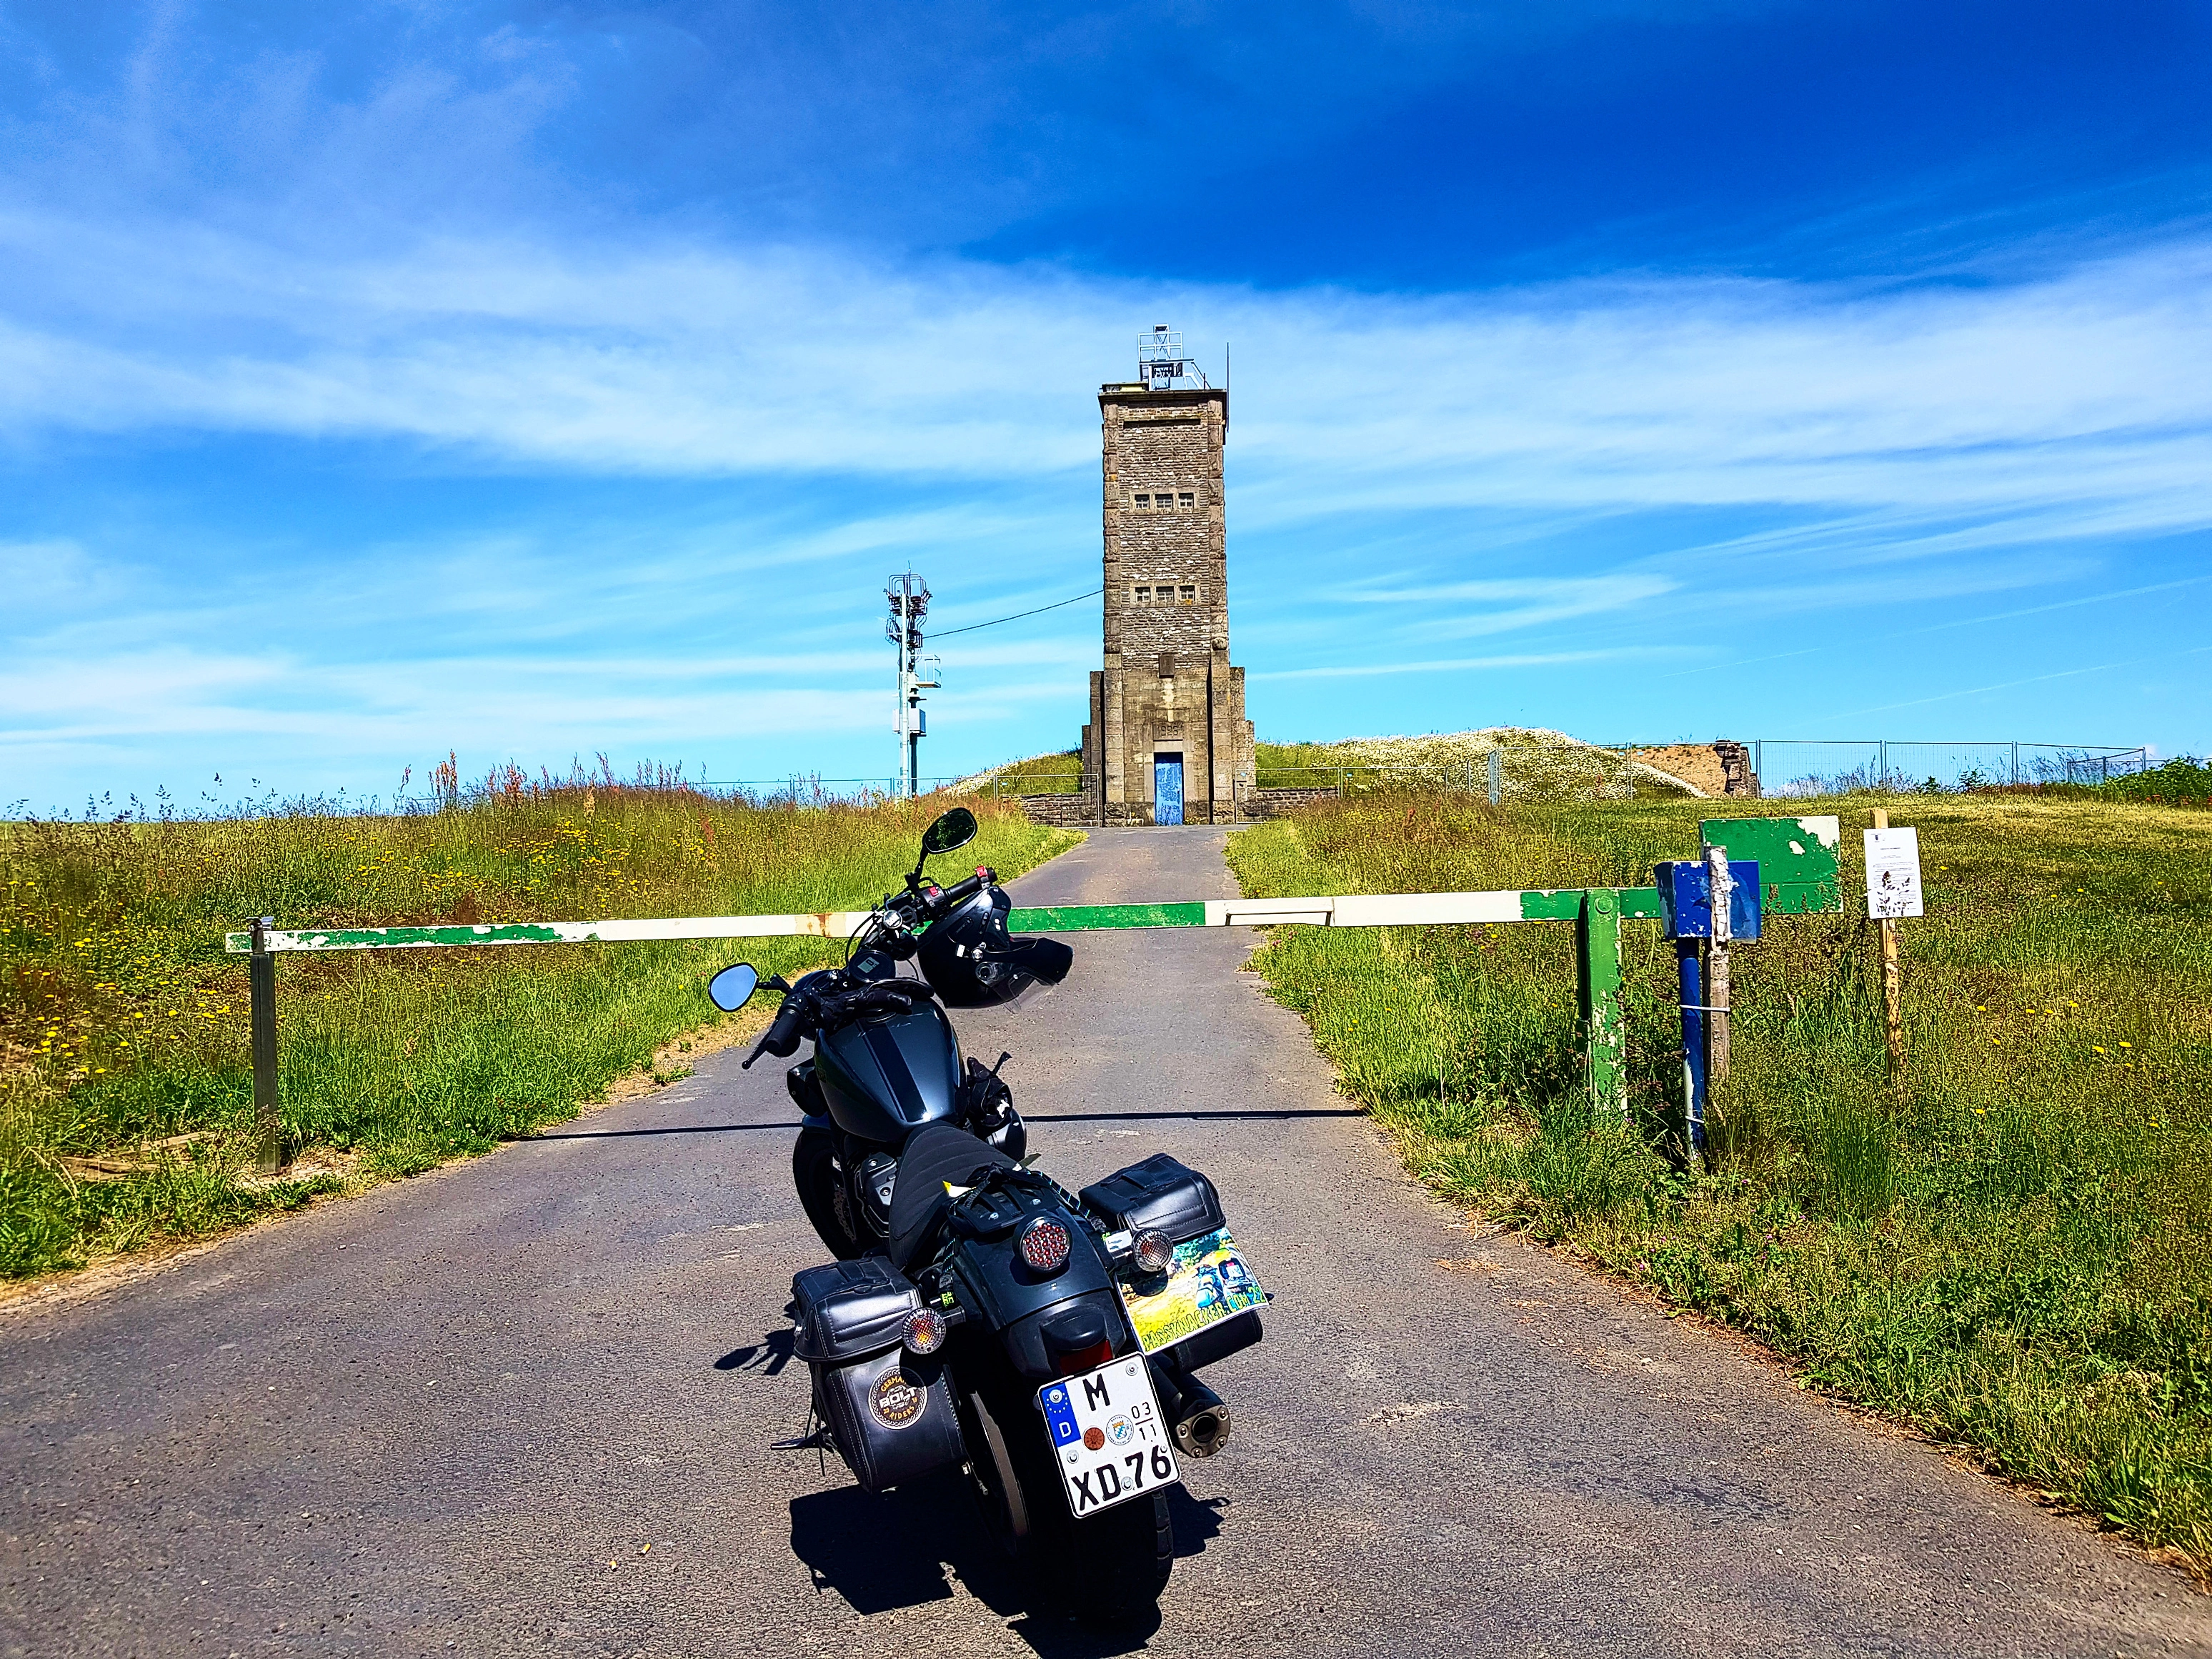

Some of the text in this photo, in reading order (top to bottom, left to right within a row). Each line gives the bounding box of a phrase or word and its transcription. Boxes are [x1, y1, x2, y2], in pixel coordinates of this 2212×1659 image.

[1141, 1285, 1266, 1352] PASSKNACKER.COM 22
[879, 1386, 917, 1408] BOLT
[1082, 1373, 1110, 1411] M
[889, 1405, 915, 1420] RIDERS
[1131, 1402, 1151, 1419] 03
[1059, 1422, 1072, 1438] D
[1139, 1423, 1157, 1440] 11
[1071, 1445, 1172, 1511] XD 76
